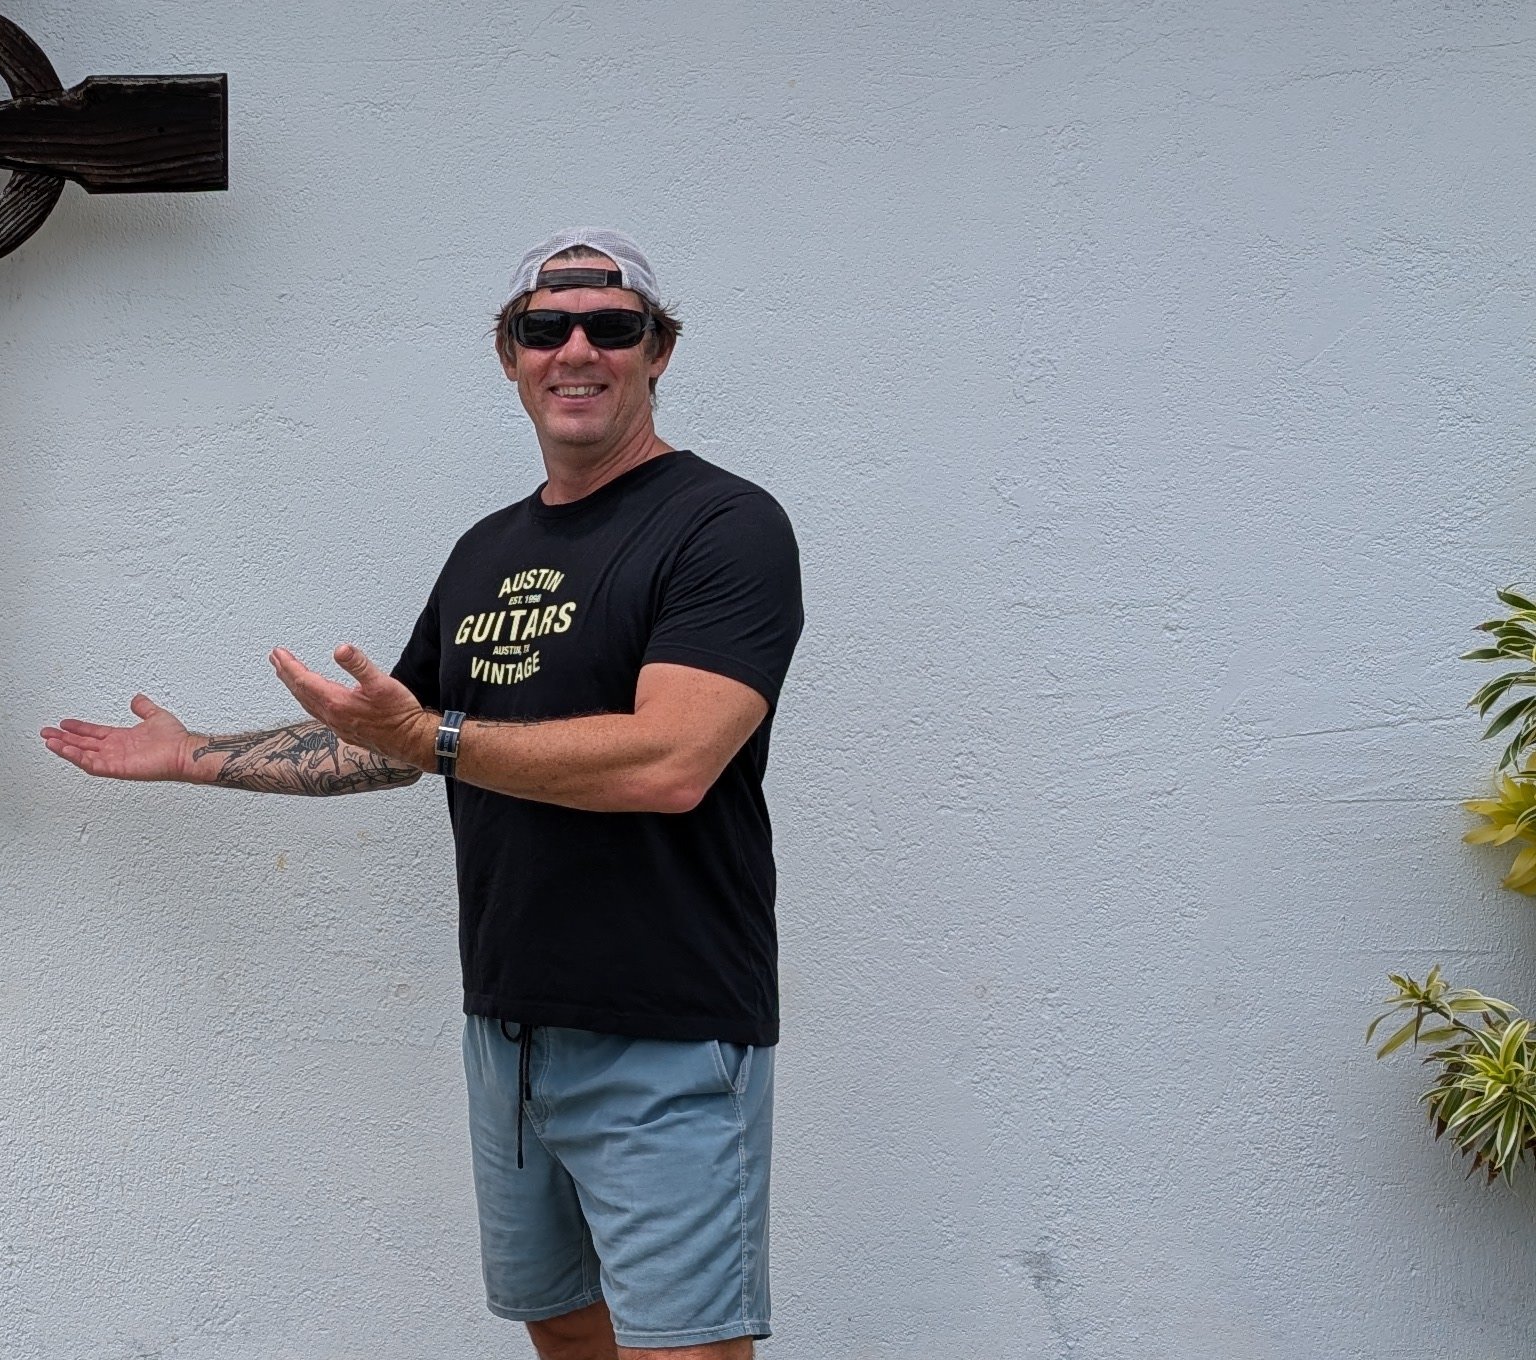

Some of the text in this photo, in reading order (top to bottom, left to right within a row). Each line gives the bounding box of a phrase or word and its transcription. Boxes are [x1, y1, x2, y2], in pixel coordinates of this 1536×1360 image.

[497, 568, 565, 598] AUSTIN
[508, 596, 523, 606] EST.
[454, 601, 577, 645] GUITARS
[471, 650, 541, 685] VINTAGE
